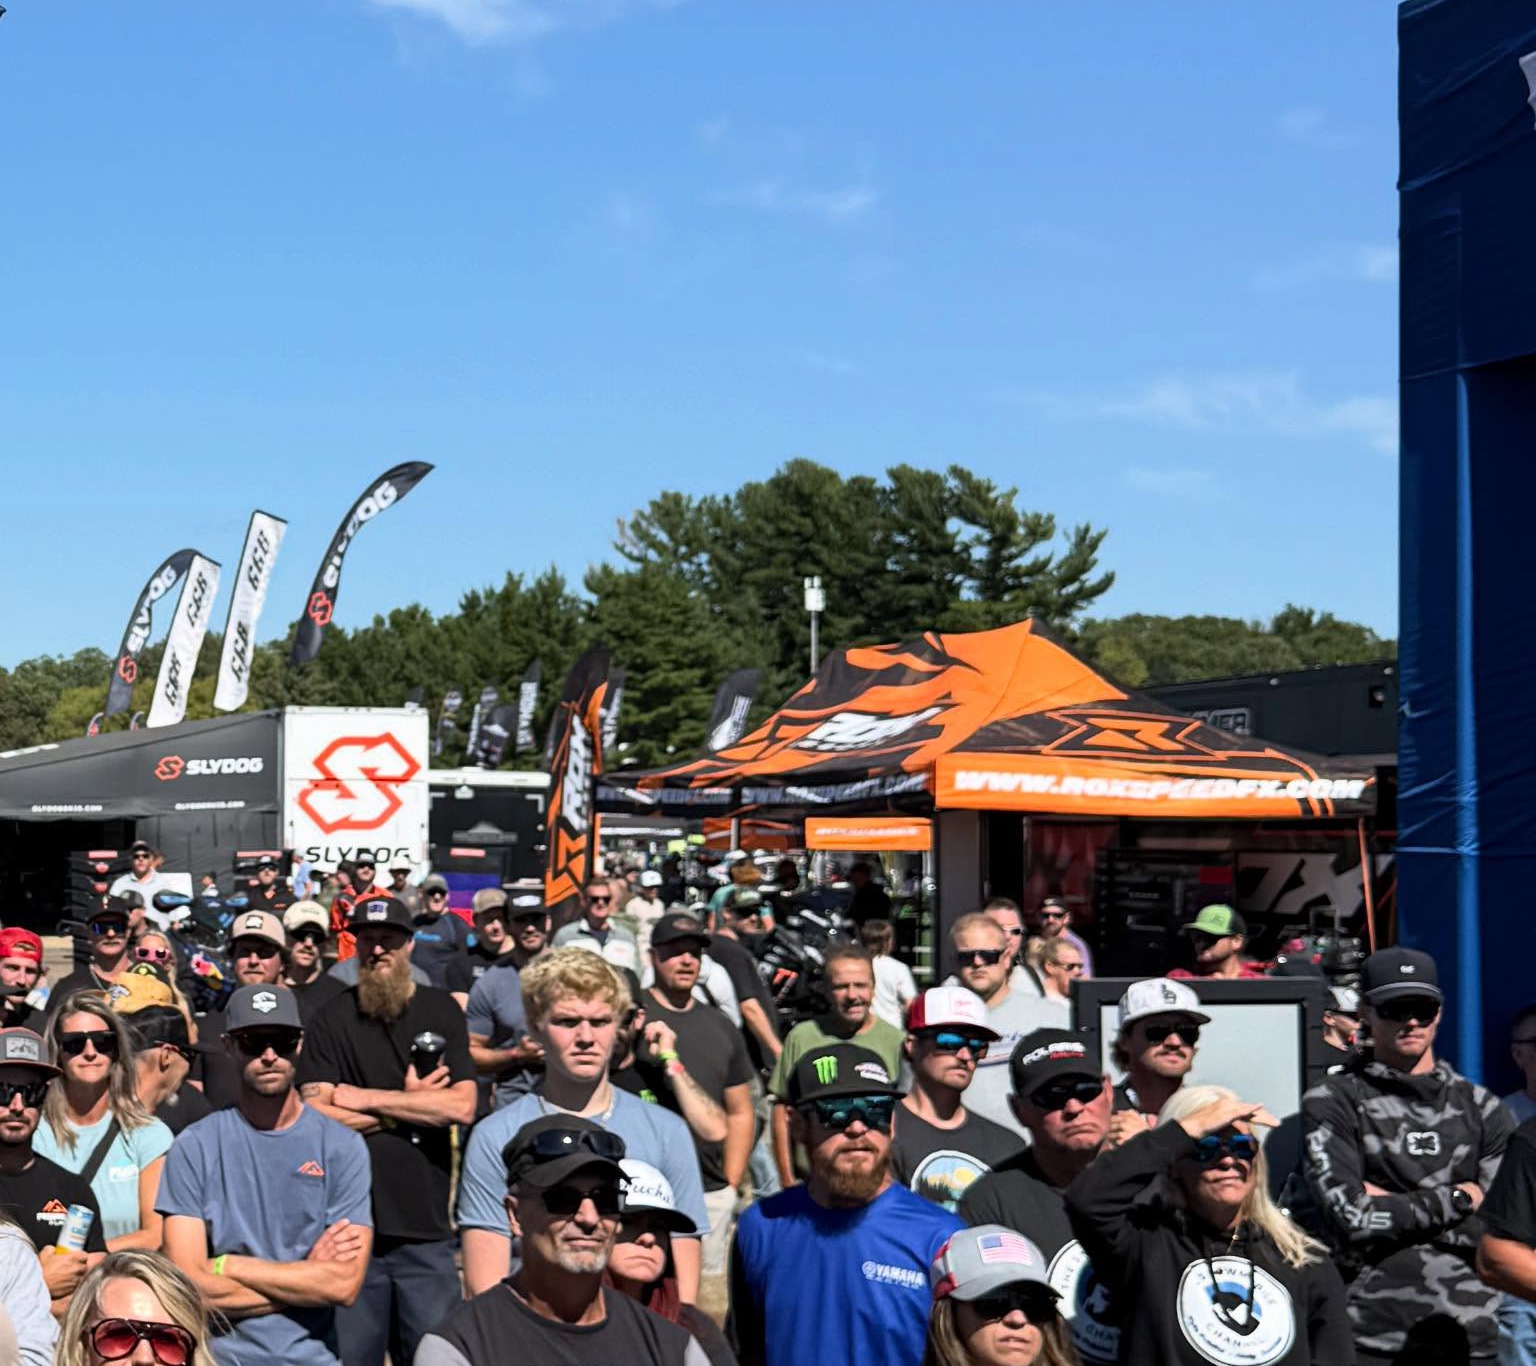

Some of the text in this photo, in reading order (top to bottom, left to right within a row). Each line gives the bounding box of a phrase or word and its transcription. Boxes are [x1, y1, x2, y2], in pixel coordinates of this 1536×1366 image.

[127, 565, 177, 653] SLYOG
[185, 757, 263, 776] SLYDOG
[953, 770, 1365, 800] WWW.ROXSPEEDFX.COM
[875, 1263, 924, 1286] YAMAHA
